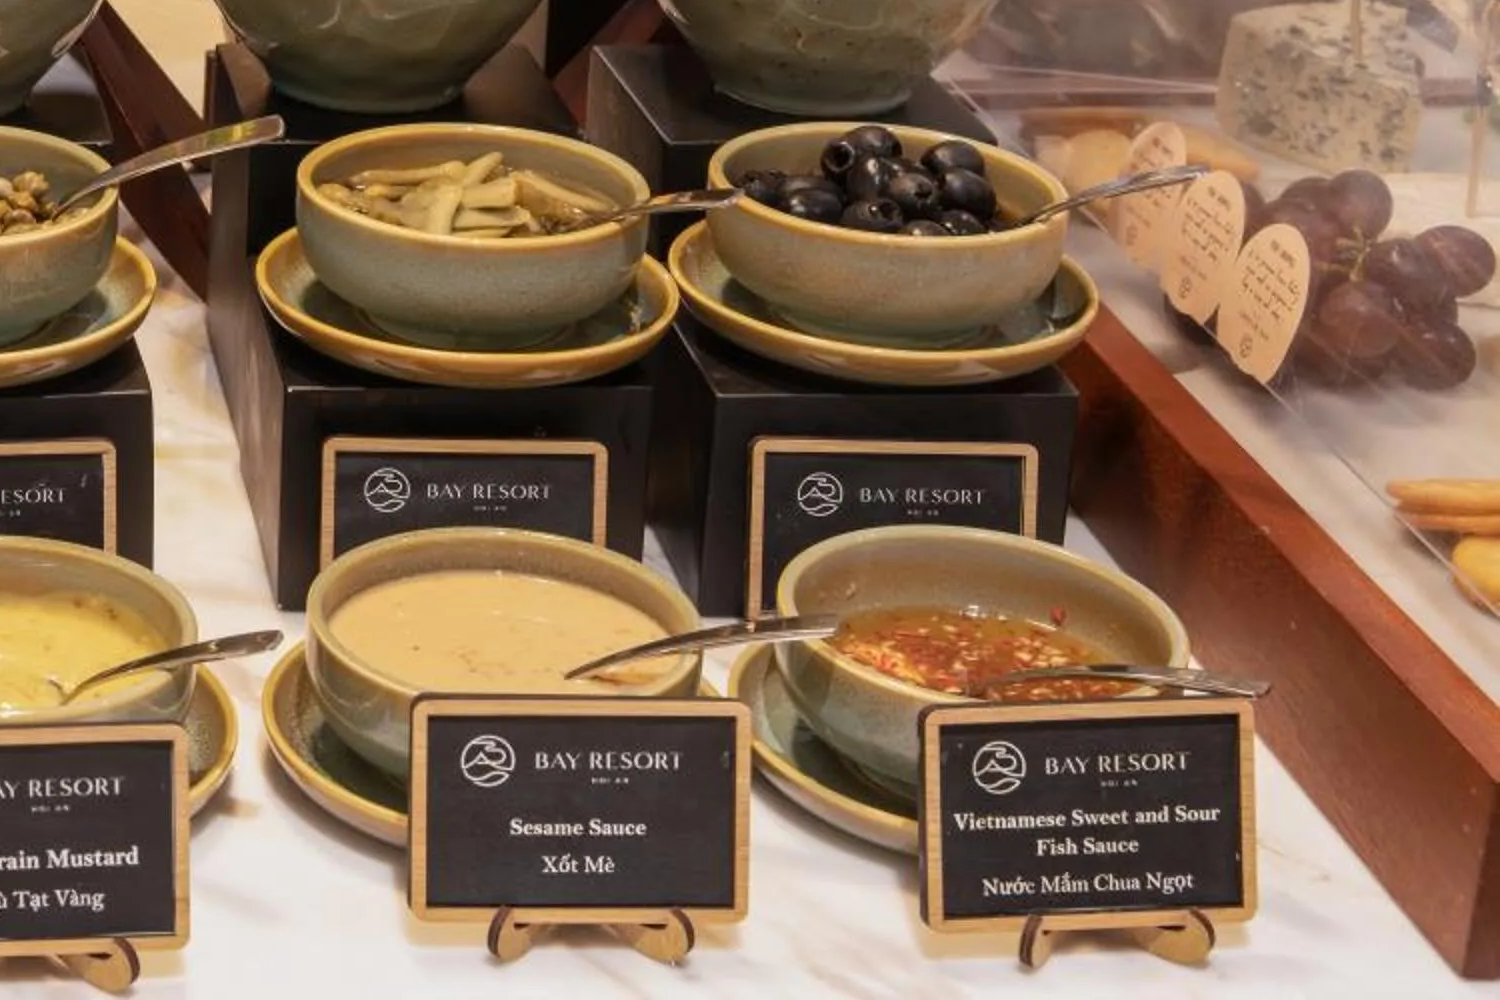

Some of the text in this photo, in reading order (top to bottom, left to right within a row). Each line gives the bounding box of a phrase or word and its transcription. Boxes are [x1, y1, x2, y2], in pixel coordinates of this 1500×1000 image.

[427, 484, 550, 500] BAY RESORT
[859, 487, 986, 505] BAY RESORT
[535, 751, 683, 770] BAY RESORT
[1045, 752, 1191, 776] BAY RESORT
[28, 776, 125, 798] RESORT
[510, 818, 647, 836] Sesame Sauce
[954, 805, 1221, 831] Vietnamese Sweet and Sour
[46, 845, 140, 869] Mustard
[1036, 837, 1139, 856] Fish Sauce
[542, 853, 615, 873] Xốt Mè
[982, 877, 1035, 896] Nước
[1093, 873, 1141, 891] Chua
[1146, 872, 1195, 895] Ngọt
[12, 890, 49, 911] Tạt
[54, 889, 105, 910] Vàng
